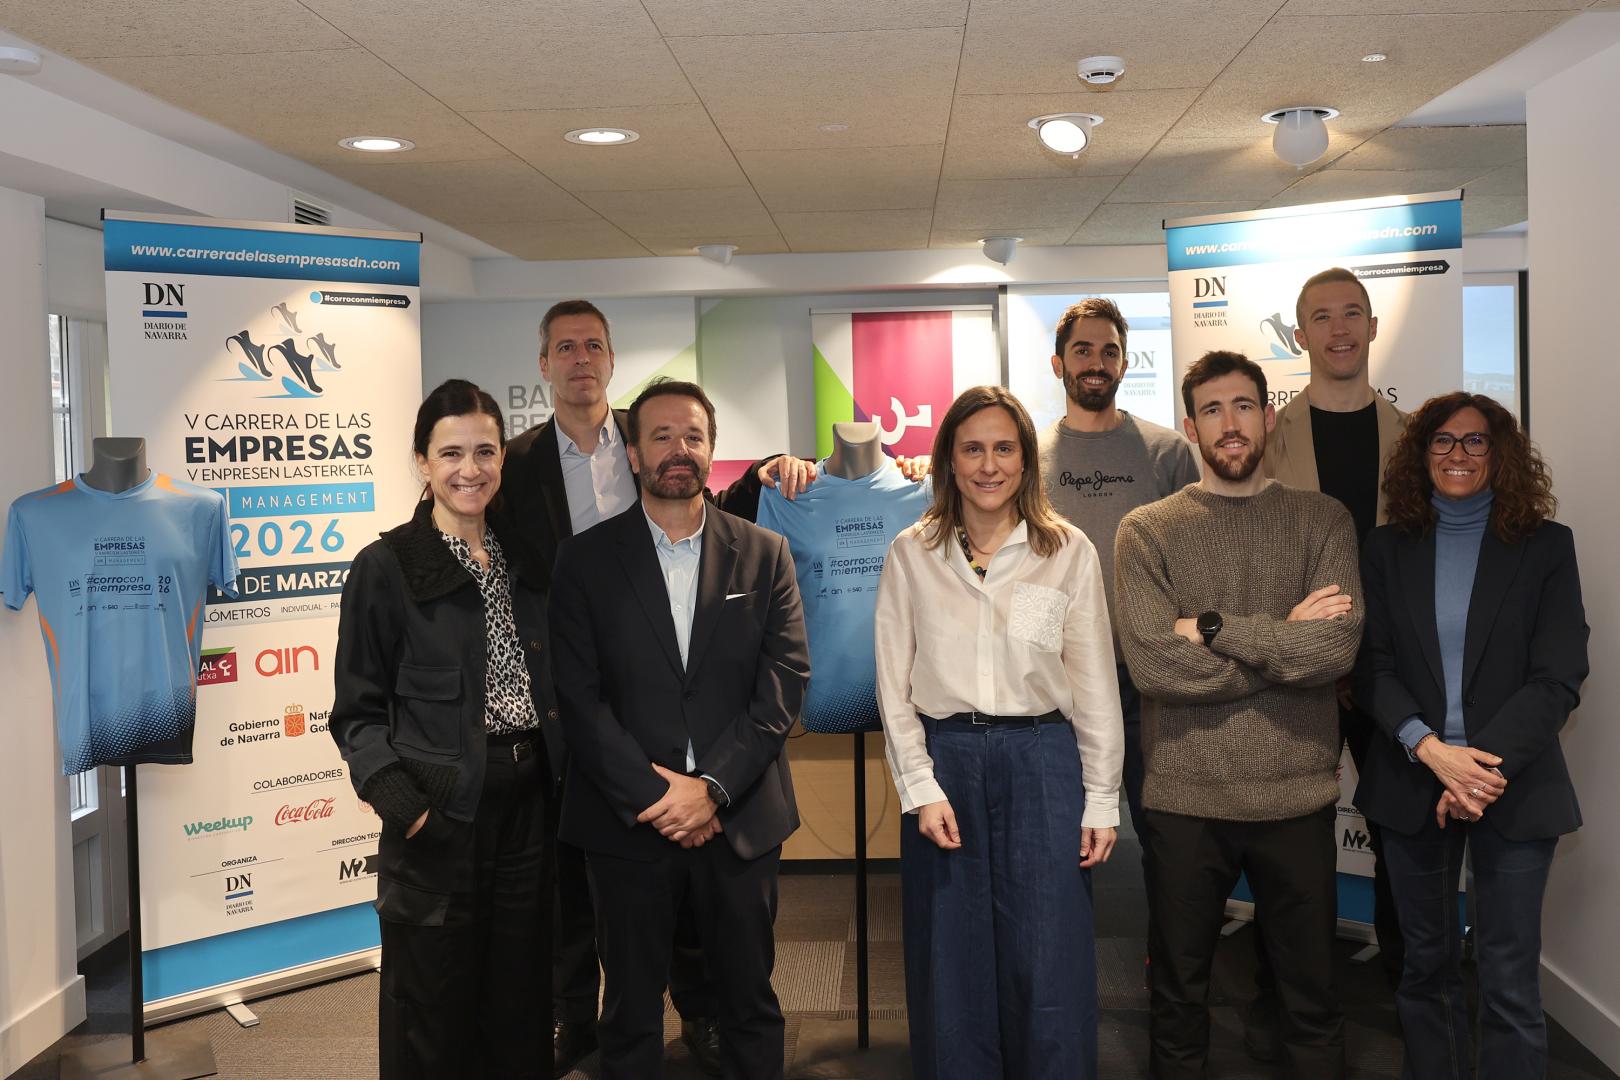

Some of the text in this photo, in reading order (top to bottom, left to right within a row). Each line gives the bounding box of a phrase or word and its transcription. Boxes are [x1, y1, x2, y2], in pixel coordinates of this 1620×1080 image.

[130, 244, 401, 271] www.carreradelasempresasdn.com
[142, 282, 185, 306] DN
[1194, 276, 1227, 298] DN
[324, 294, 406, 306] #corroconmiempresa
[144, 322, 187, 331] DIARIO DE
[1194, 319, 1228, 328] NAVARRA
[144, 331, 188, 340] NAVARRA
[184, 412, 372, 431] V CARRERA DE LAS
[185, 433, 373, 464] EMPRESAS
[187, 464, 374, 481] V ENPRESEN LASTERKETA
[1060, 471, 1135, 490] Pepe Jeans
[241, 491, 369, 510] MANAGEMENT
[835, 521, 884, 533] EMPRESAS
[231, 518, 345, 558] 2026
[94, 542, 145, 551] EMPRESAS
[830, 556, 884, 568] #corrocon
[86, 575, 144, 585] #corrocon
[158, 576, 171, 584] 20
[244, 575, 271, 595] DE
[87, 583, 151, 594] miempresa
[158, 585, 170, 594] 26
[204, 606, 271, 623] LÓMETROS
[280, 604, 322, 613] INDIVIDUAL
[255, 645, 320, 677] ain
[197, 671, 217, 681] utxa
[229, 718, 280, 732] Gobierno
[309, 724, 330, 734] Gob
[220, 731, 281, 747] de Navarra
[253, 768, 343, 791] COLABORADORES
[274, 797, 336, 826] Coca-Cola
[183, 815, 253, 836] Weekup
[331, 834, 367, 847] DIRECCIÓN
[221, 856, 258, 868] ORGANIZA
[225, 873, 253, 892] DN
[226, 906, 254, 916] NAVARRA
